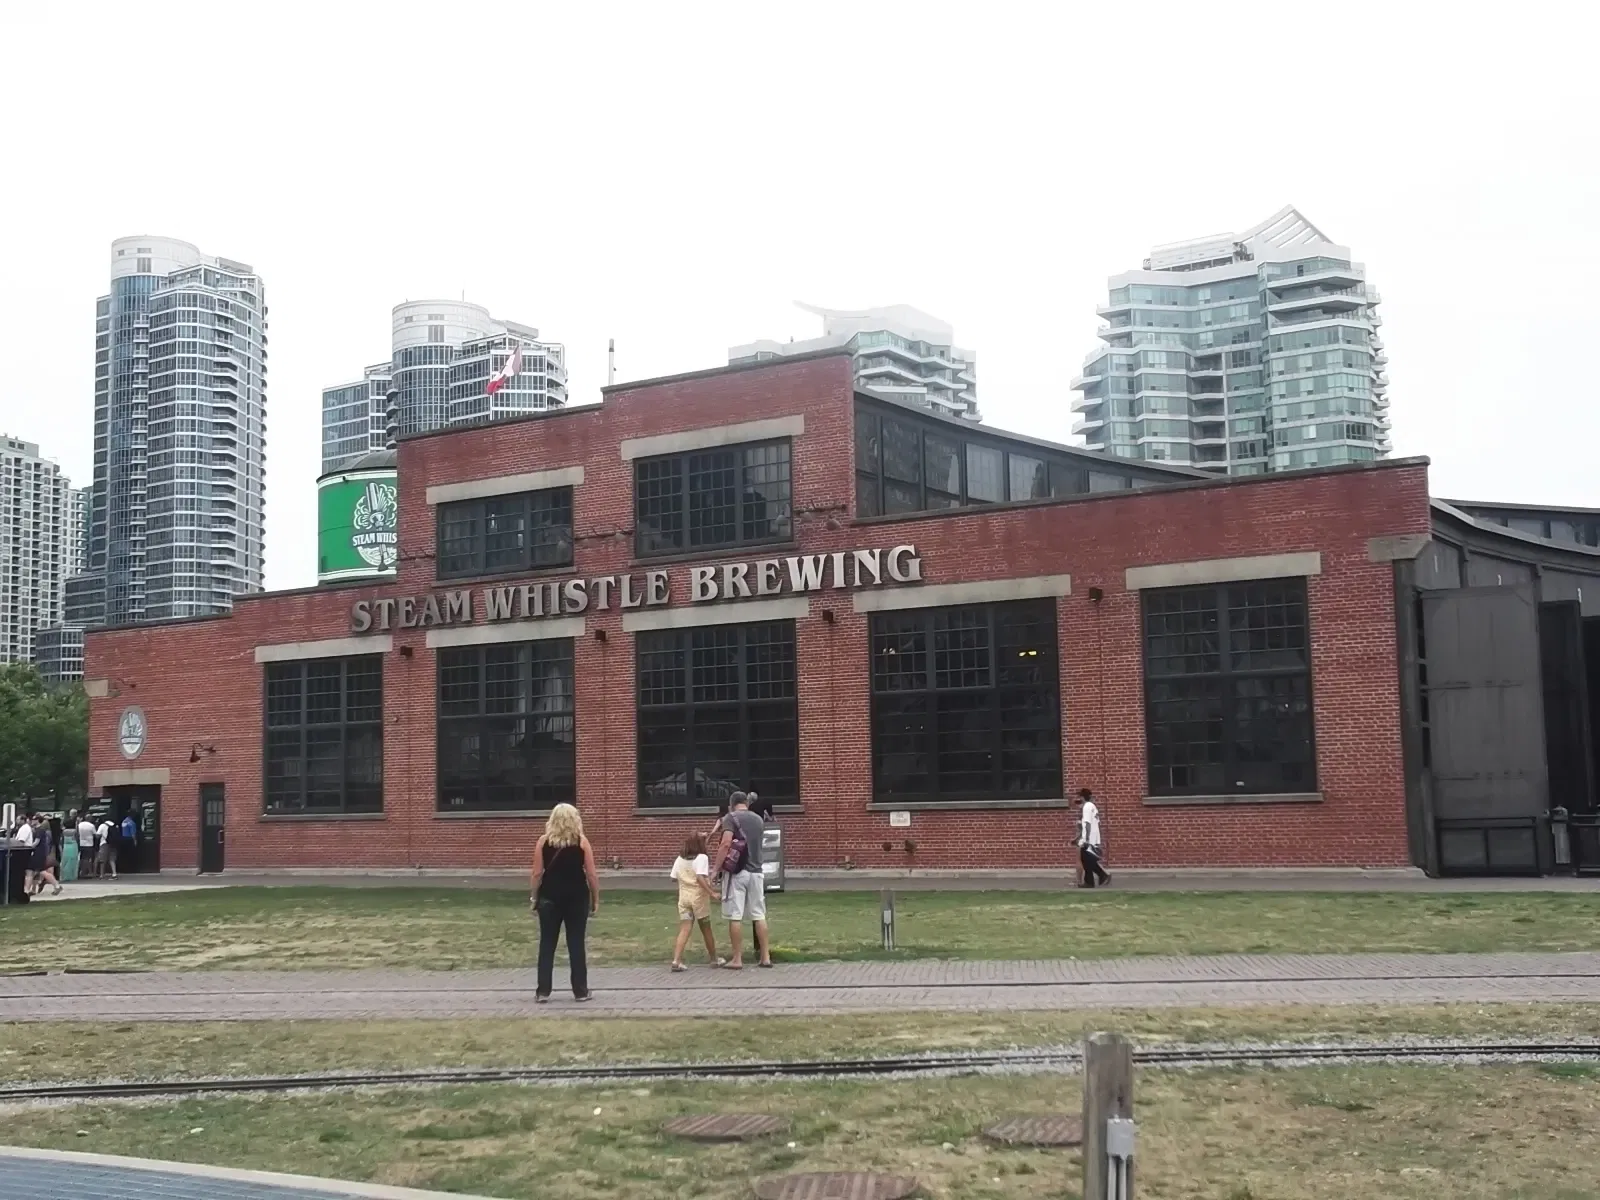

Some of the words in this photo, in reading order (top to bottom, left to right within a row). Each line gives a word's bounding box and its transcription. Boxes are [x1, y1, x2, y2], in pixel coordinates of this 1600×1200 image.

[352, 533, 376, 546] STEAM
[352, 591, 472, 632] STEAM
[483, 570, 671, 620] WHISTLE
[690, 545, 922, 601] BREWING
